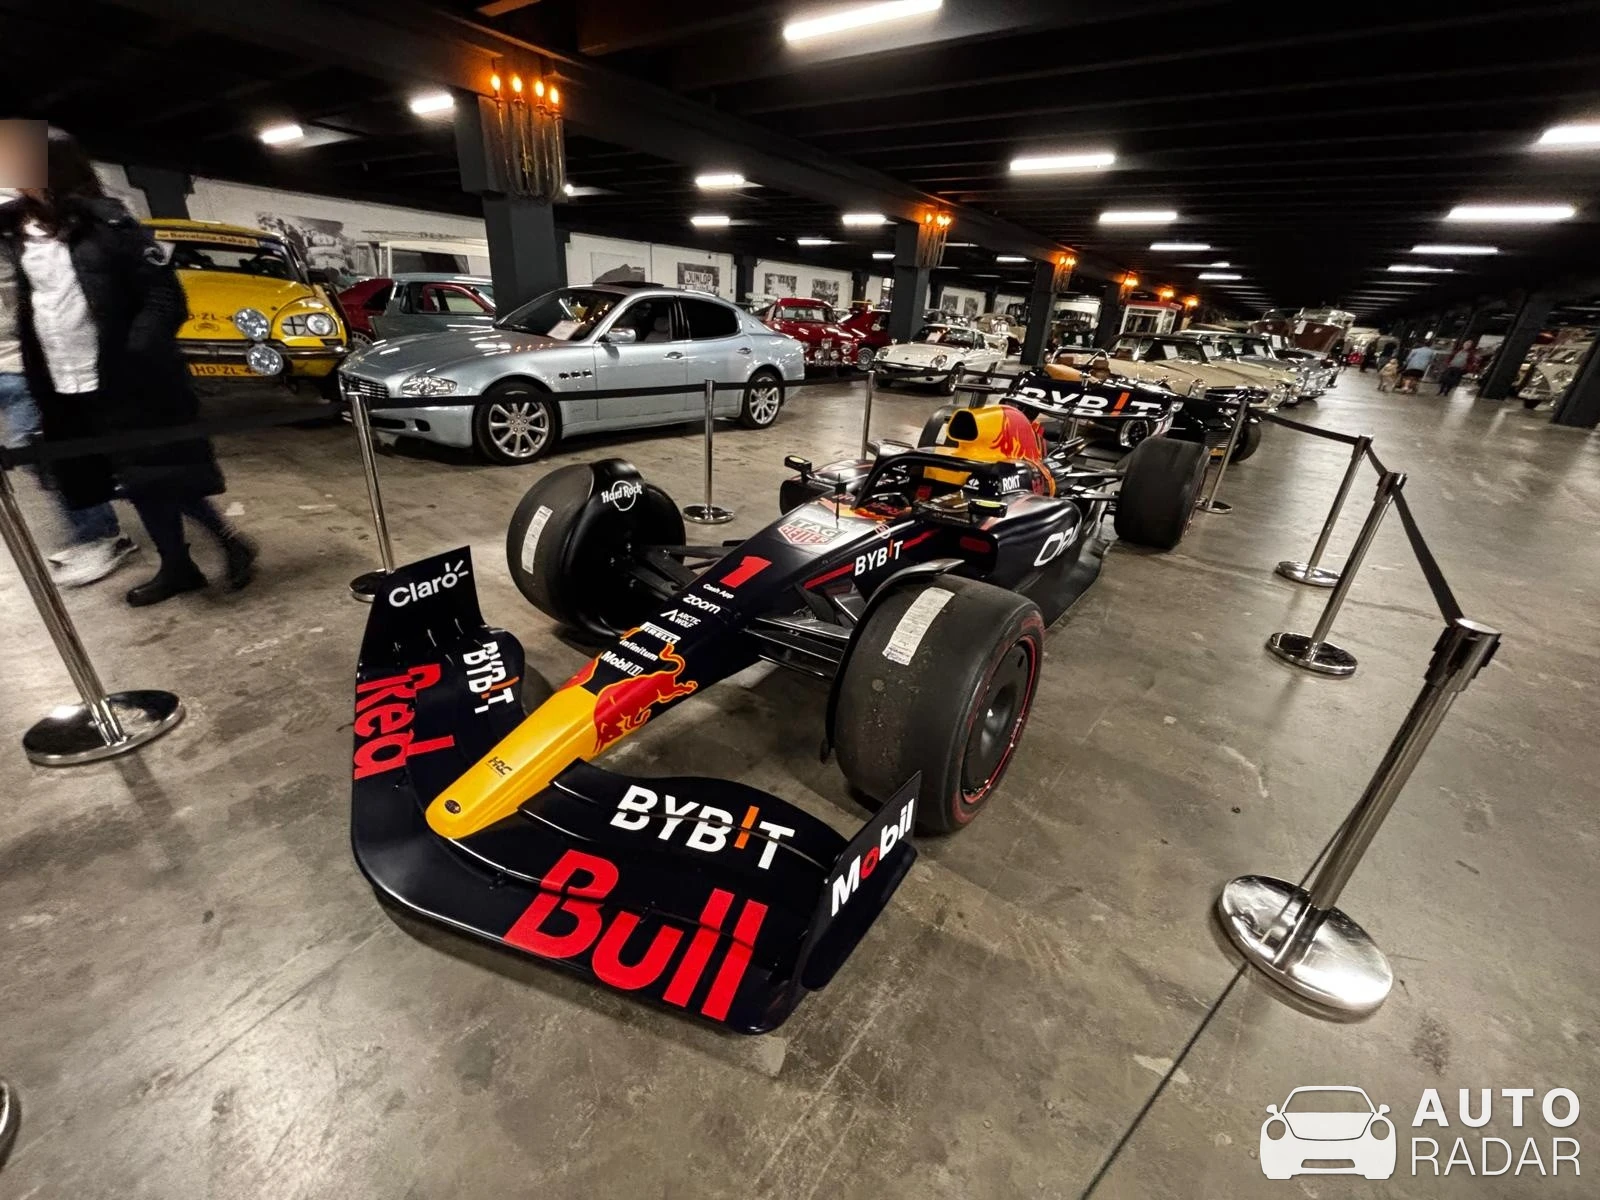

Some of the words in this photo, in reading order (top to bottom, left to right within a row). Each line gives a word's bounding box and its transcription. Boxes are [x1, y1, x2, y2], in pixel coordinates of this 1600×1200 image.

[601, 486, 624, 503] Hard
[622, 481, 642, 498] Rock
[793, 520, 839, 538] TAG
[854, 539, 903, 577] BYBIT
[720, 555, 772, 588] 1
[388, 570, 459, 608] Claro
[702, 583, 720, 594] Cash
[719, 589, 734, 599] App
[682, 593, 721, 614] zoom
[674, 618, 695, 628] WOLF
[677, 612, 701, 625] ARCTIC
[640, 621, 681, 644] PIRELLI
[601, 650, 633, 671] Mobil
[619, 638, 658, 661] infinitum
[462, 640, 520, 715] BYBIT
[353, 662, 456, 780] Red
[610, 784, 796, 870] BYBIT
[829, 799, 913, 917] Mobil
[503, 848, 769, 1022] Bull
